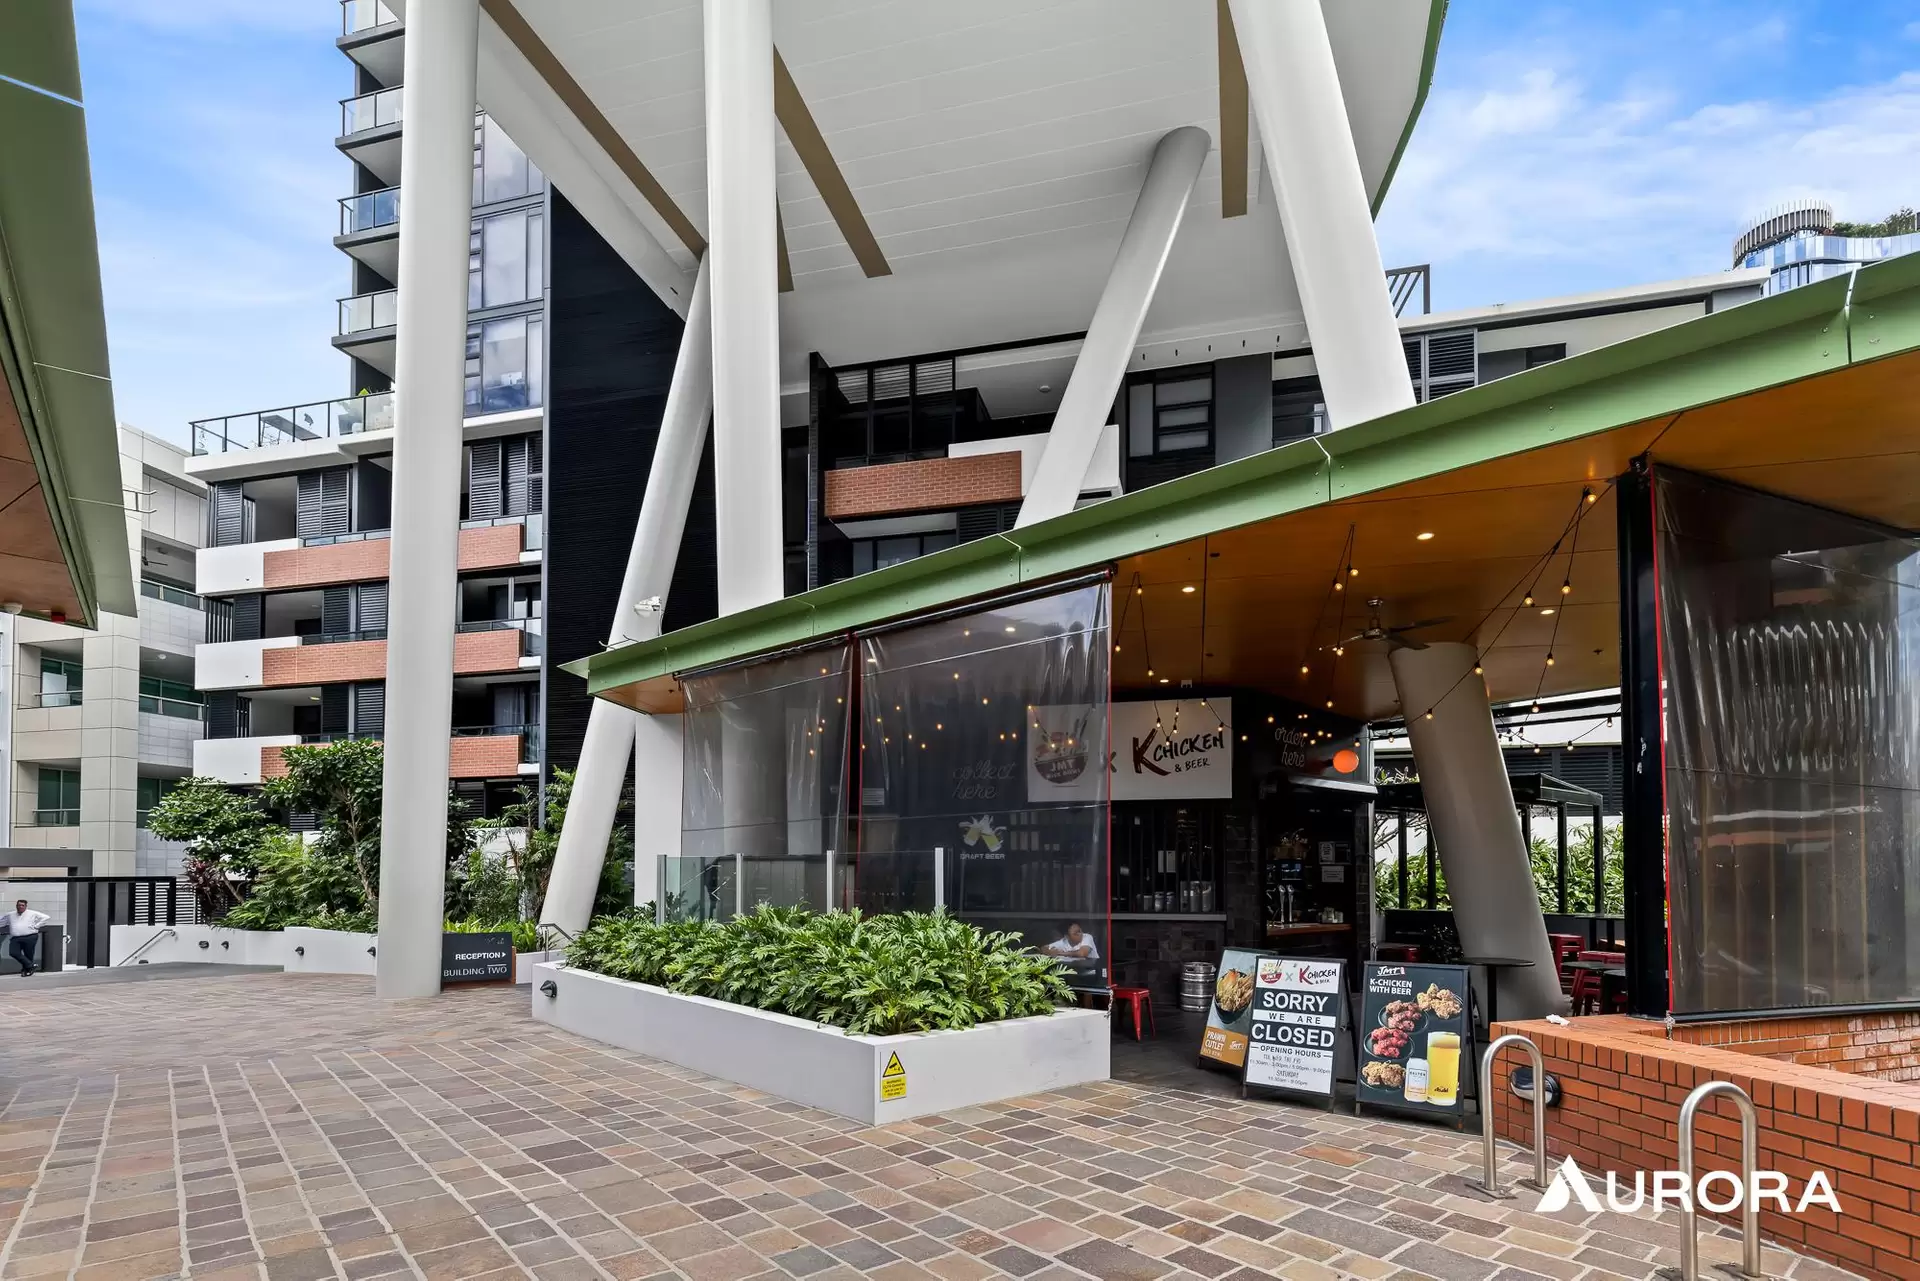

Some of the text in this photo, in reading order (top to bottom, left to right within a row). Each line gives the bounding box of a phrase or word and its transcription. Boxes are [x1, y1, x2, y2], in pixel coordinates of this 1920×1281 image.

[1275, 727, 1306, 747] order
[1281, 742, 1305, 768] here
[1174, 757, 1211, 773] & BEER
[951, 781, 999, 800] here
[455, 952, 501, 961] RECEPTION
[443, 966, 507, 977] BUILDING TWO
[1369, 978, 1413, 988] K-CHICKEN
[1369, 985, 1412, 996] WITH BEER
[1263, 992, 1328, 1012] SORRY
[1268, 1012, 1322, 1025] WE ARE
[1251, 1023, 1335, 1048] CLOSED
[1260, 1046, 1322, 1059] OPENING HOURS
